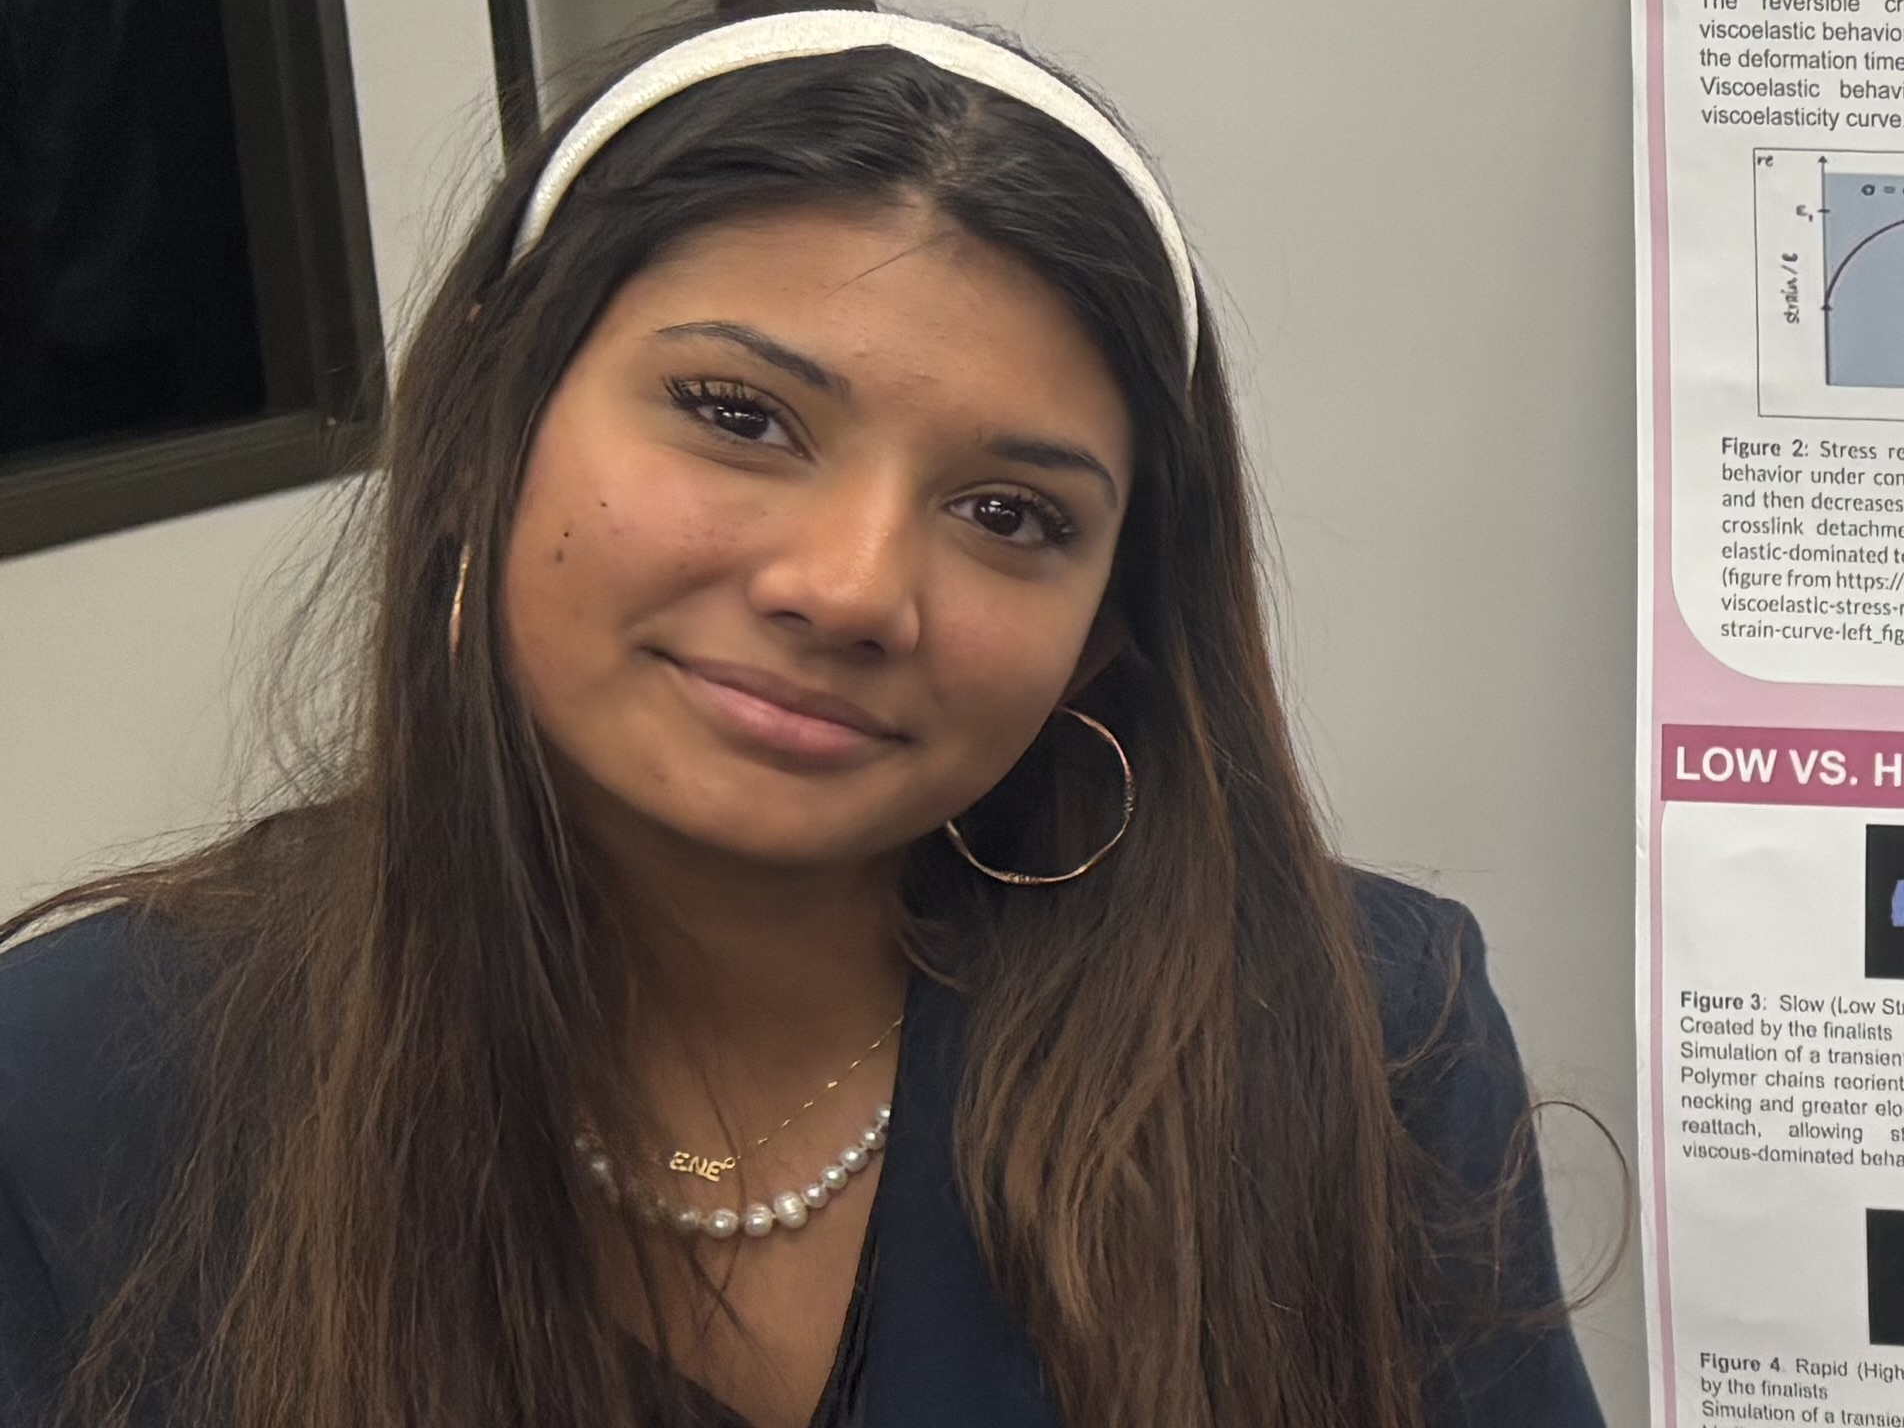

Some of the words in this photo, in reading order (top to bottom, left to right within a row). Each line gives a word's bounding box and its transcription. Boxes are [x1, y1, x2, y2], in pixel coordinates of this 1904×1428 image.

[1676, 746, 1777, 783] LOW
[1789, 750, 1858, 786] VS.
[669, 1151, 720, 1182] ENE
